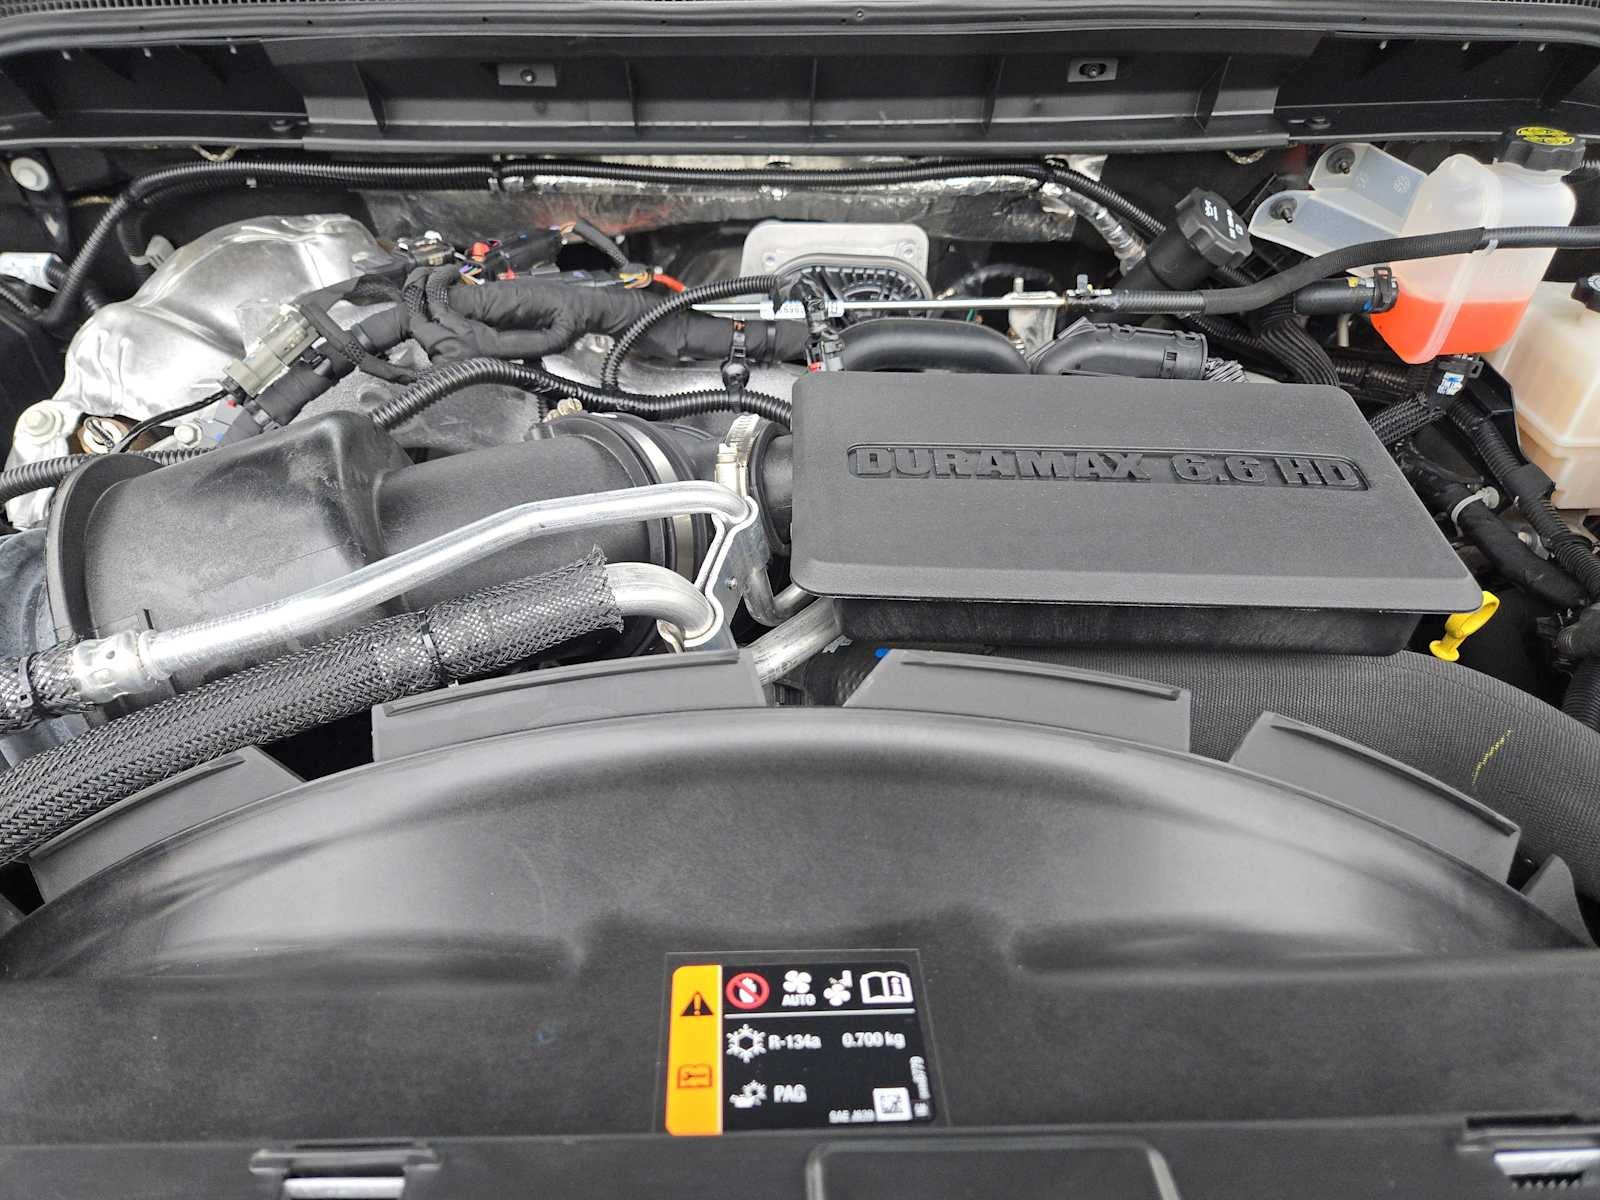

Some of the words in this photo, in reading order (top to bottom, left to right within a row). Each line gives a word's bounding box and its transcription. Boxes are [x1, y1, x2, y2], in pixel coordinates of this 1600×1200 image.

[855, 447, 1151, 480] DURAMAX
[1170, 454, 1267, 485] 6.6
[1274, 456, 1362, 489] HD
[781, 993, 816, 1006] AUTO
[768, 1033, 822, 1051] R-134a
[885, 1031, 906, 1050] kg
[773, 1084, 808, 1103] PAG
